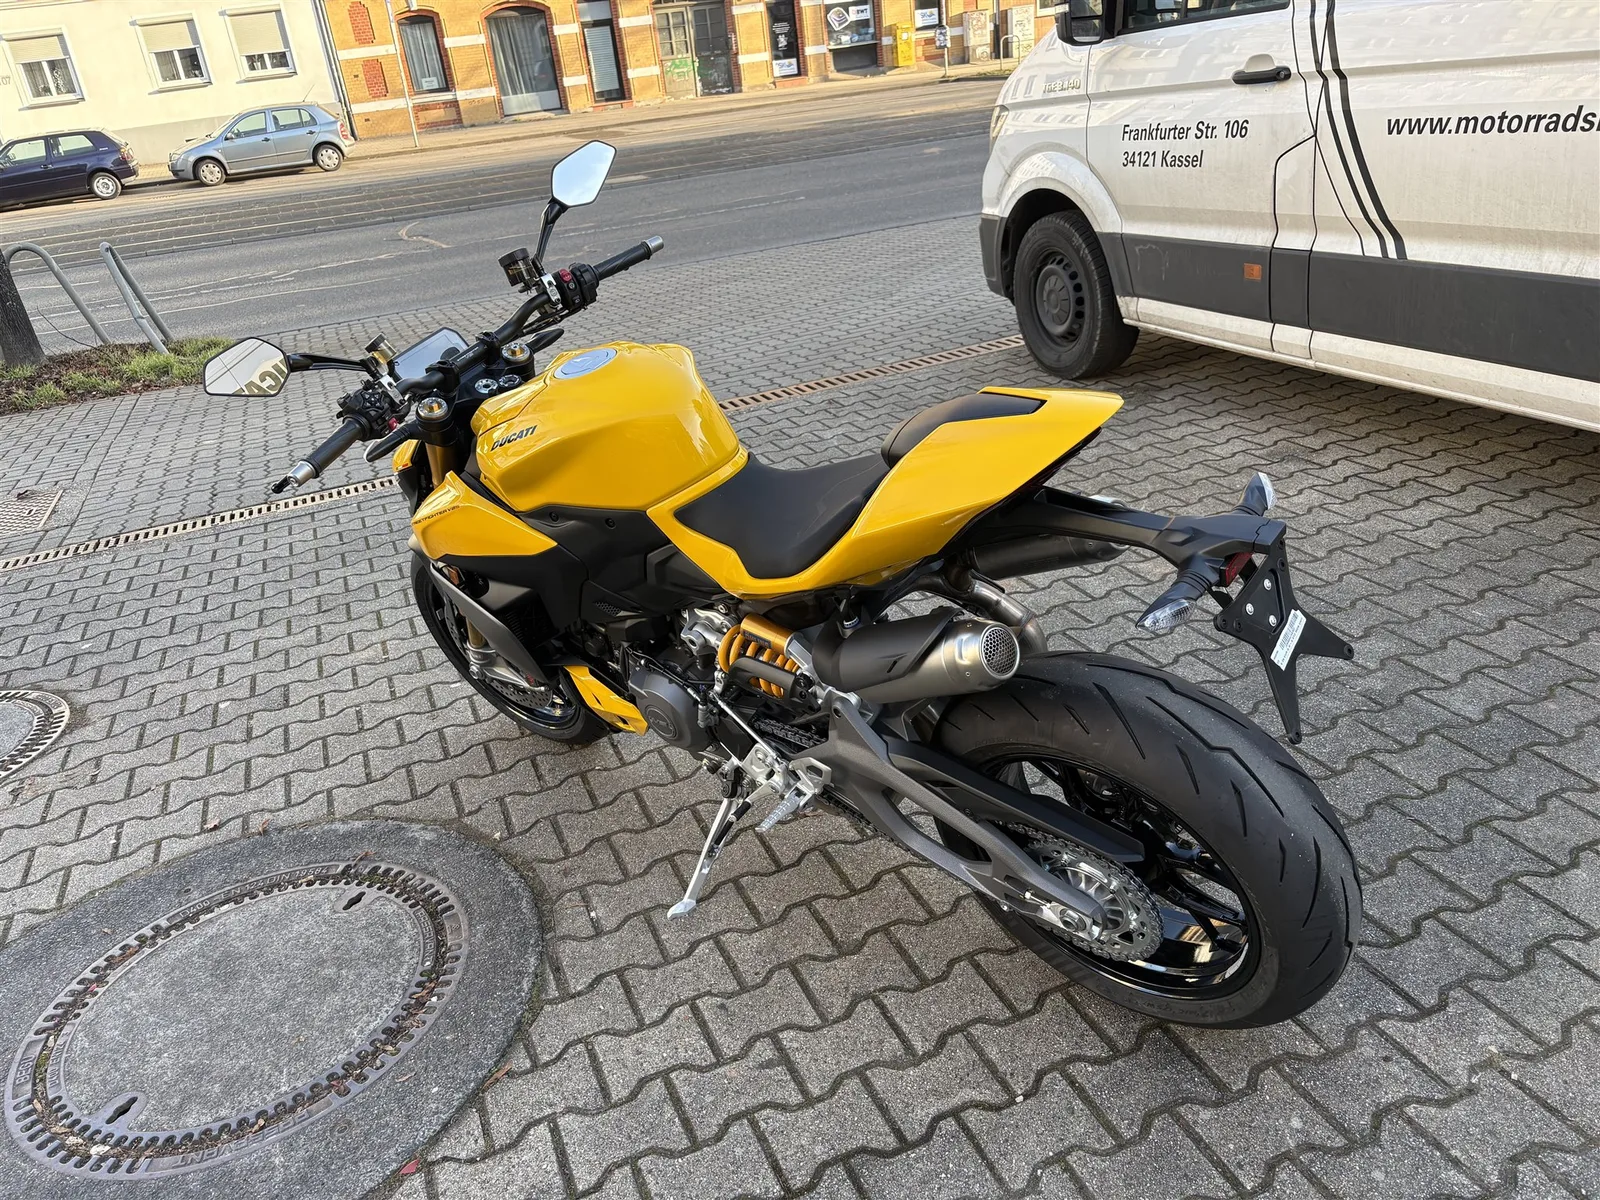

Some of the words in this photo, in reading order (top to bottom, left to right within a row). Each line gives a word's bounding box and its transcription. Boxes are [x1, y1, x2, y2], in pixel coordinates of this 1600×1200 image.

[1121, 122, 1192, 141] Frankfurter
[1194, 120, 1218, 140] Str.
[1224, 119, 1250, 139] 106
[1122, 150, 1157, 168] 34121
[1160, 149, 1204, 168] Kassel
[490, 424, 538, 452] DUCATI
[179, 900, 211, 918] D400
[221, 888, 242, 899] EN
[266, 873, 291, 885] DIN
[15, 1054, 36, 1085] BEGU
